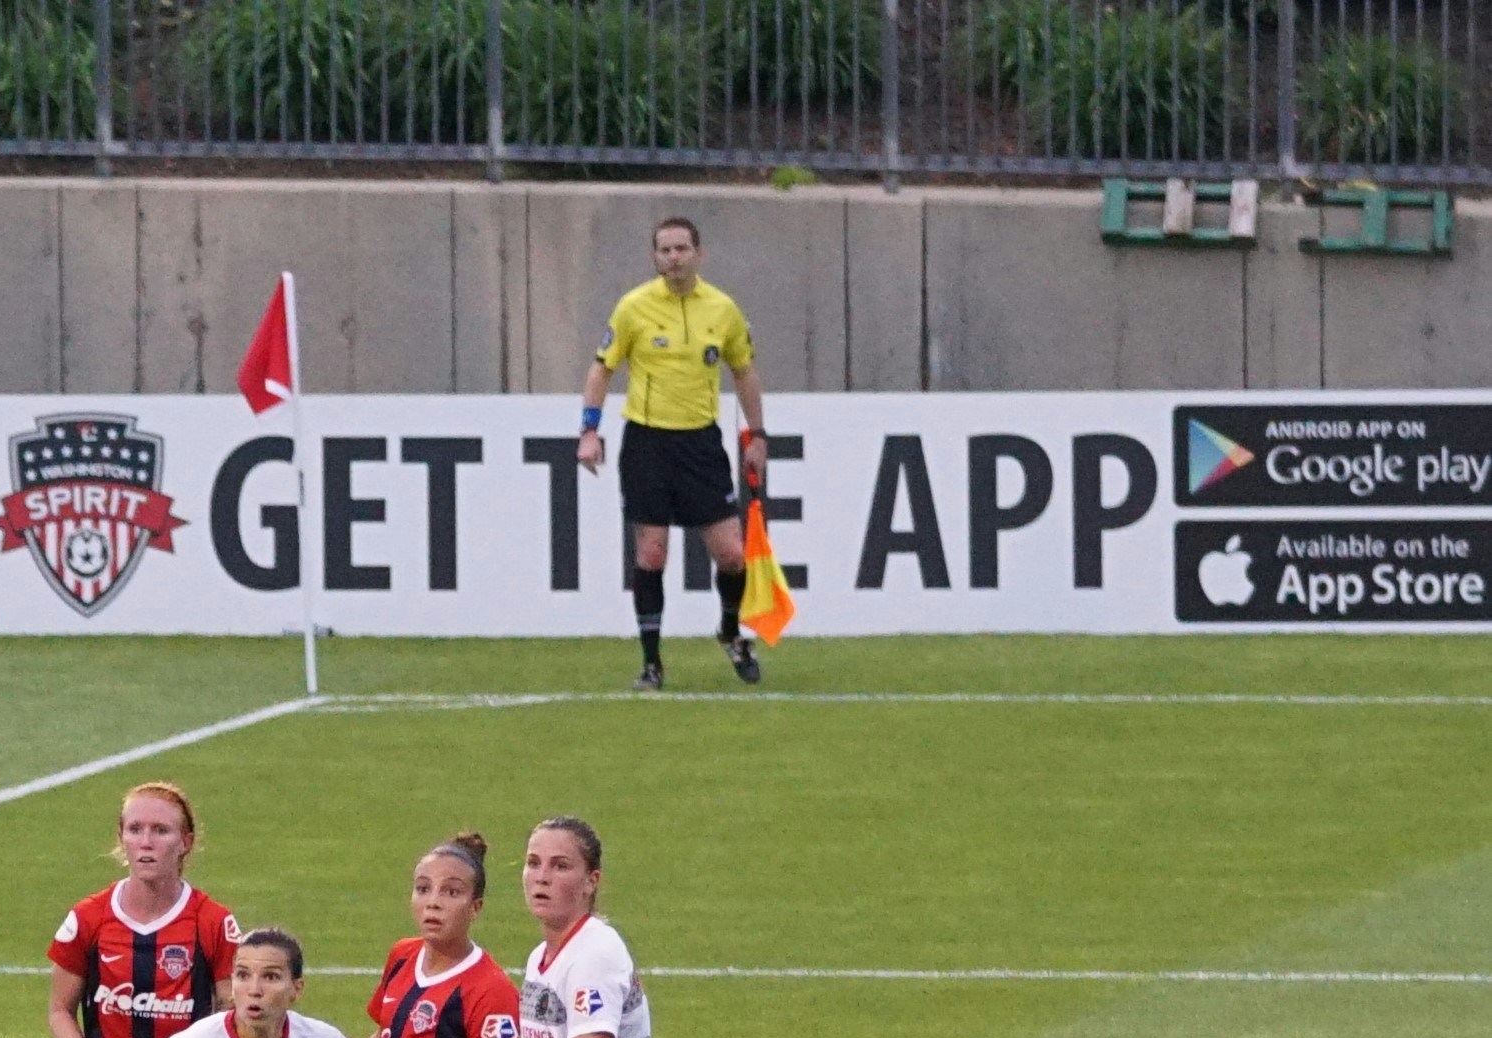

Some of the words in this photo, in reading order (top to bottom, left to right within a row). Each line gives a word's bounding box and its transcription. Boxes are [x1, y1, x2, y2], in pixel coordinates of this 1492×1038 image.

[1265, 420, 1351, 440] ANDROID
[1356, 420, 1393, 440] APP
[1397, 420, 1426, 439] ON
[1265, 442, 1406, 497] Google
[1417, 445, 1491, 494] play
[23, 484, 148, 521] SPIRIT
[209, 435, 483, 591] GET
[854, 433, 1158, 590] APP
[1276, 534, 1386, 559] Available
[1393, 539, 1424, 559] on
[1431, 534, 1470, 559] the
[1275, 563, 1365, 615] App
[1371, 563, 1486, 606] Store
